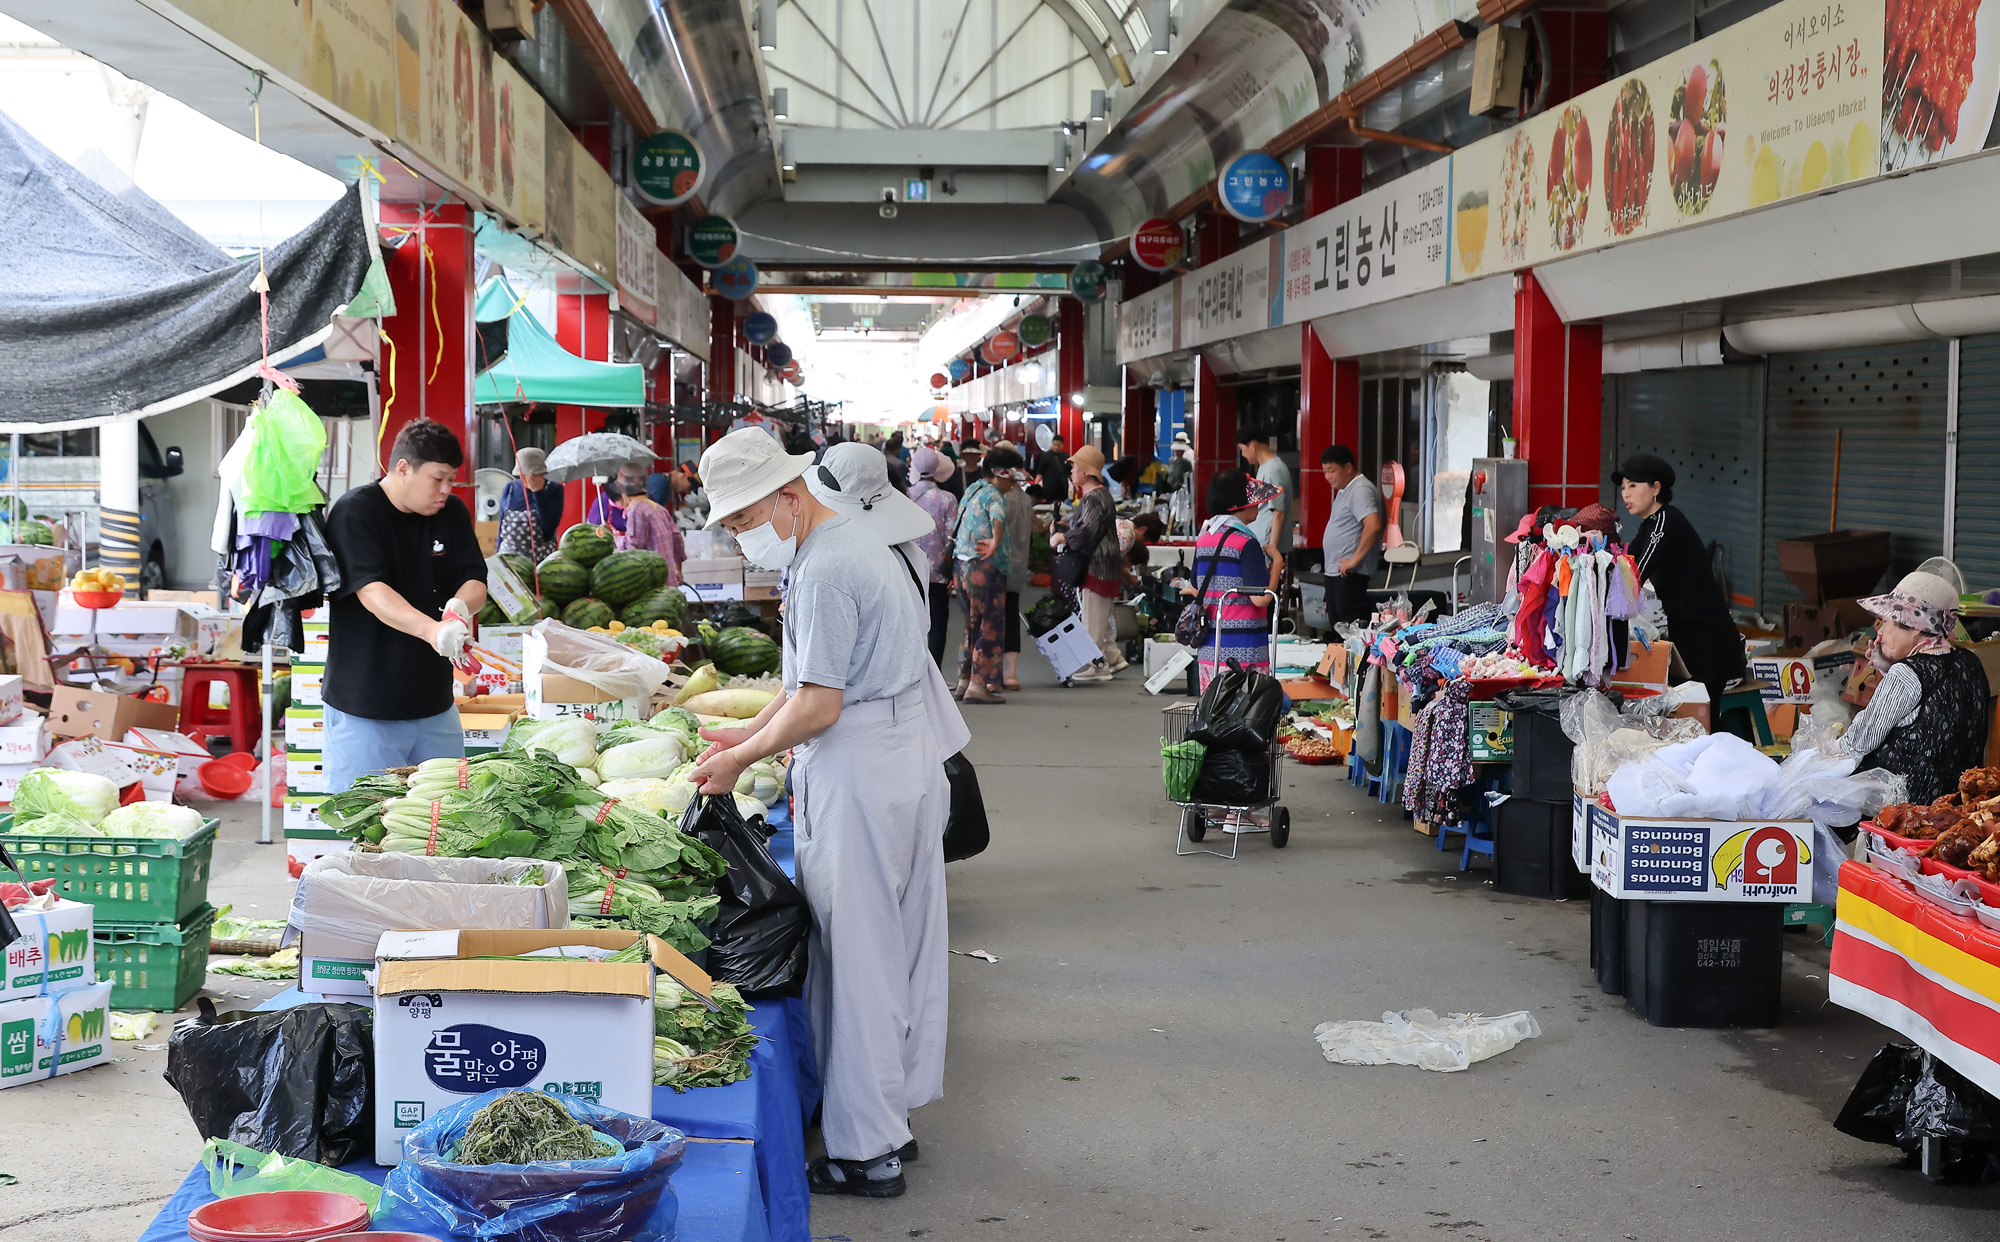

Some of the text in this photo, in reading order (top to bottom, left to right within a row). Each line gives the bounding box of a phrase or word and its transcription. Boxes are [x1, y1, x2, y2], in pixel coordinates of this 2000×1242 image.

[1783, 6, 1845, 50] 어서오이소
[1760, 96, 1868, 145] Welcome To Uiseong Market
[1314, 199, 1399, 292] 그린농산
[1631, 829, 1704, 843] Bananas
[1631, 858, 1702, 872] Bananas
[1630, 873, 1702, 887] Bananas
[1742, 884, 1797, 898] unifrutti
[1697, 939, 1742, 953] 제일식품
[9, 947, 43, 968] 배추
[409, 1007, 432, 1019] 양평
[7, 1029, 30, 1055] 쌈
[425, 1030, 539, 1084] 물 맑은 양평
